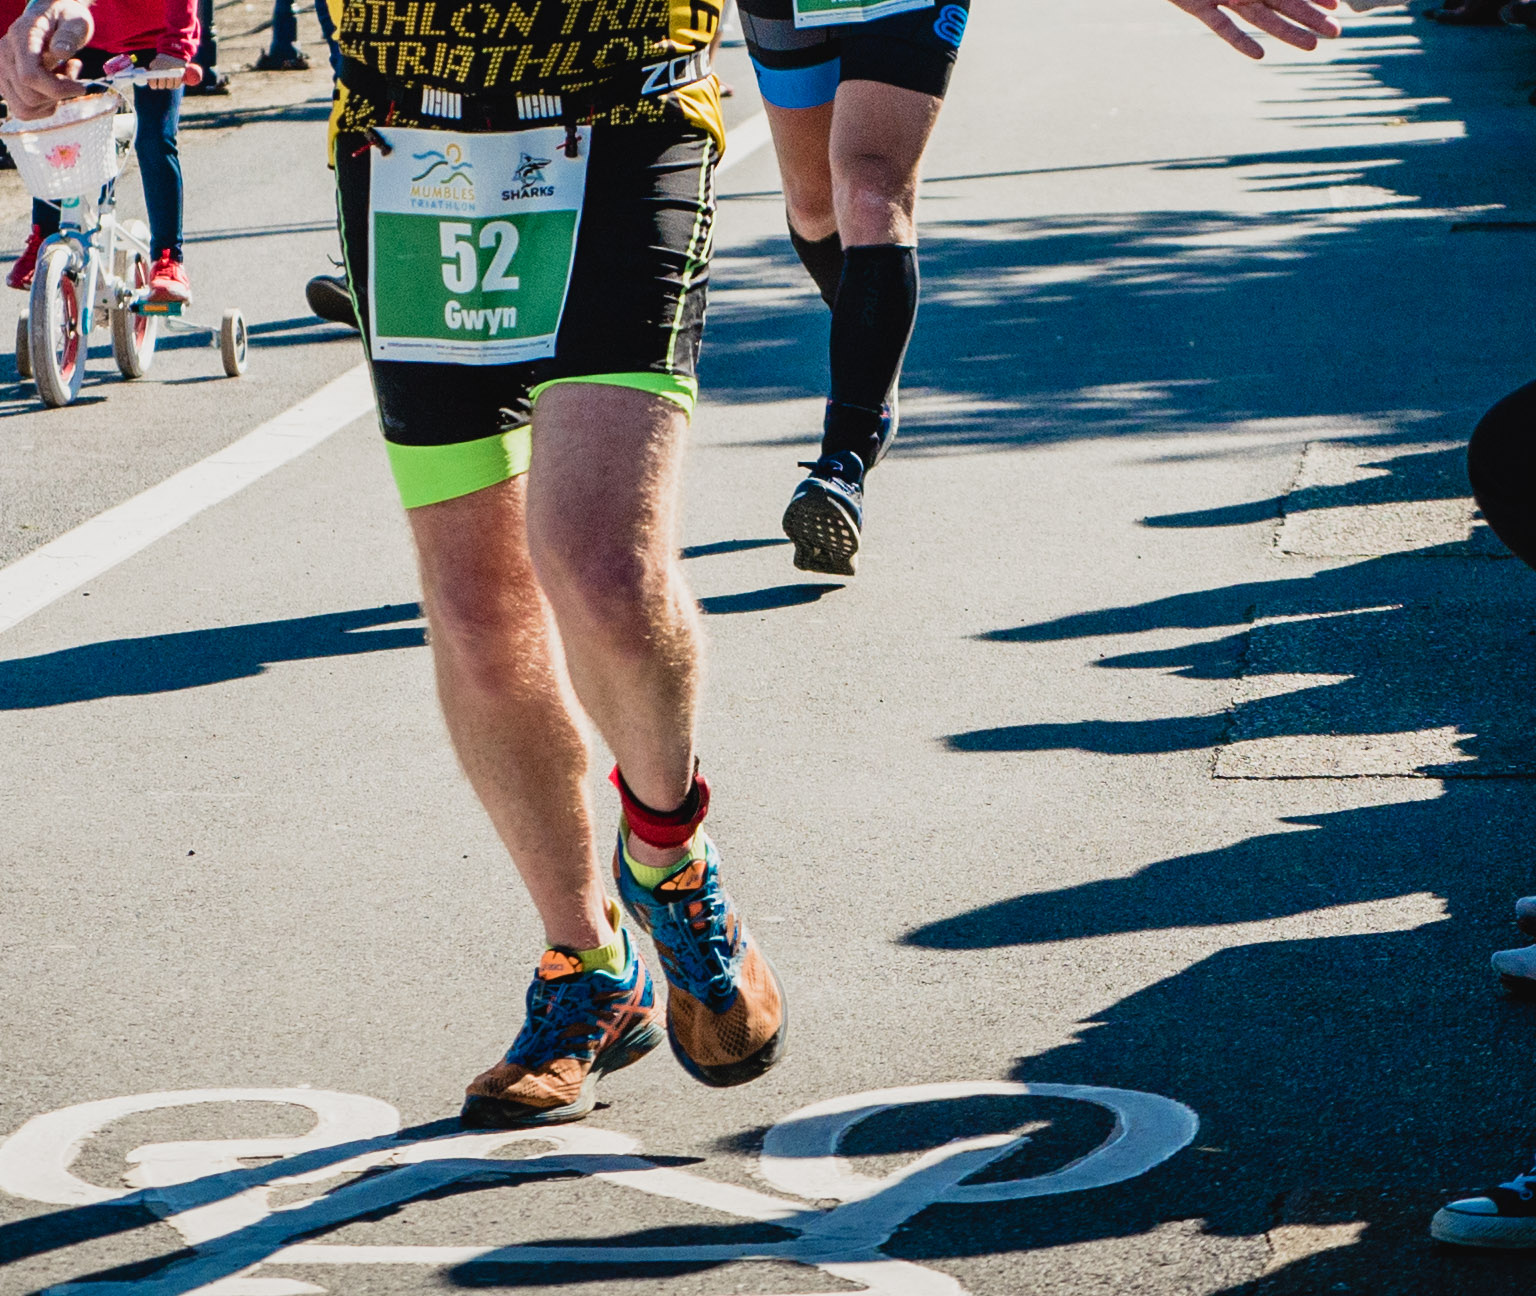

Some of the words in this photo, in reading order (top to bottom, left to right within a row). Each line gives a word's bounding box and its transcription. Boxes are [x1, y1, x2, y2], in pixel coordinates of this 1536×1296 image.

[409, 184, 476, 201] MUMBLES
[501, 185, 555, 202] SHARKS
[438, 219, 521, 295] 52
[443, 299, 518, 336] Gwyn
